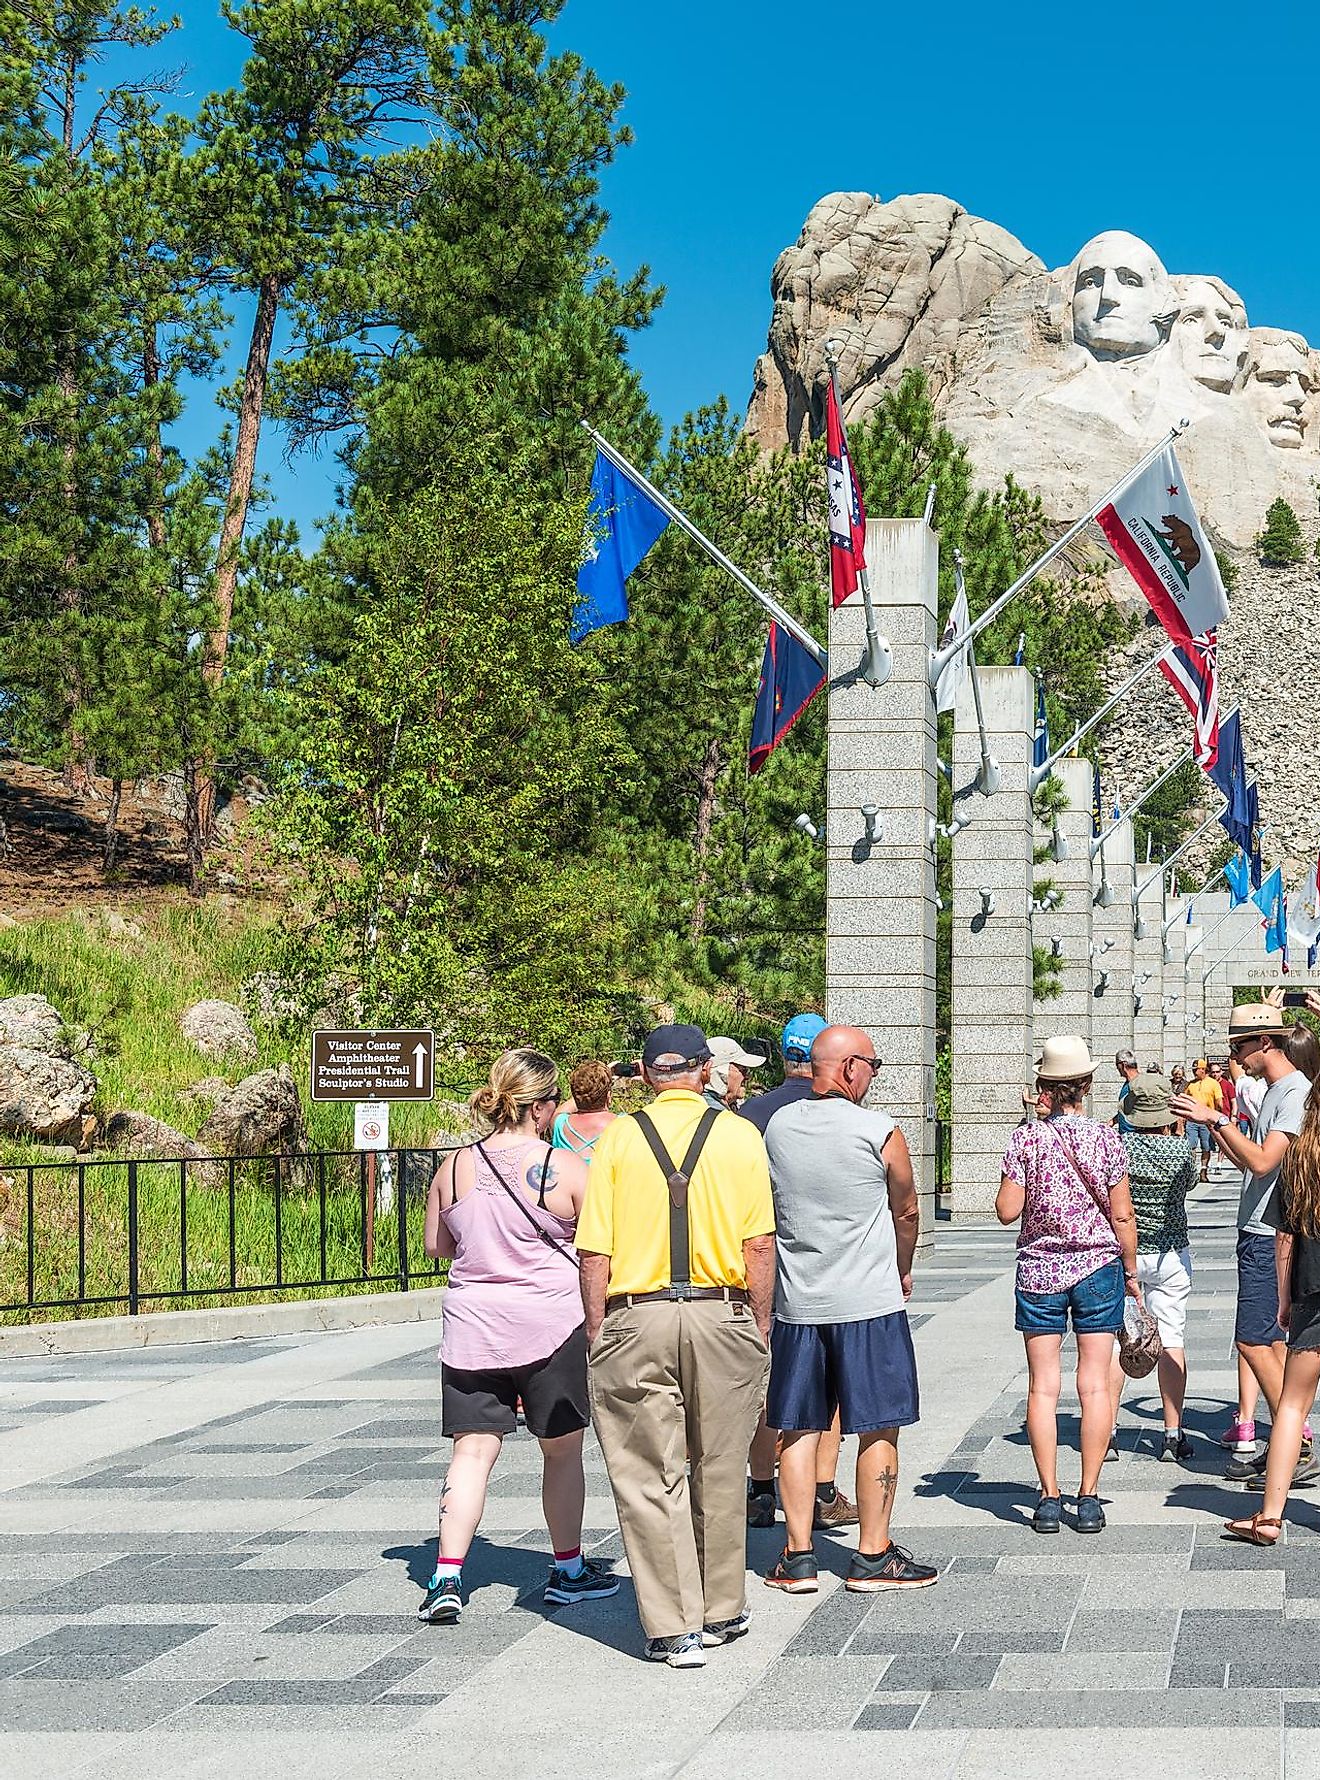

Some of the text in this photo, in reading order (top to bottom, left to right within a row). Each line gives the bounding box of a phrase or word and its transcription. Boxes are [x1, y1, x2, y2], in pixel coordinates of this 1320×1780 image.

[1127, 517, 1186, 603] CALIFORNIA REPUBLIC
[1247, 969, 1279, 978] GRAND
[1283, 969, 1301, 978] IEW
[327, 1041, 401, 1051] Visitor Center
[327, 1053, 401, 1065] Amphitheater
[318, 1066, 411, 1076] Presidential Trail
[318, 1078, 409, 1090] Sculptor's Studio
